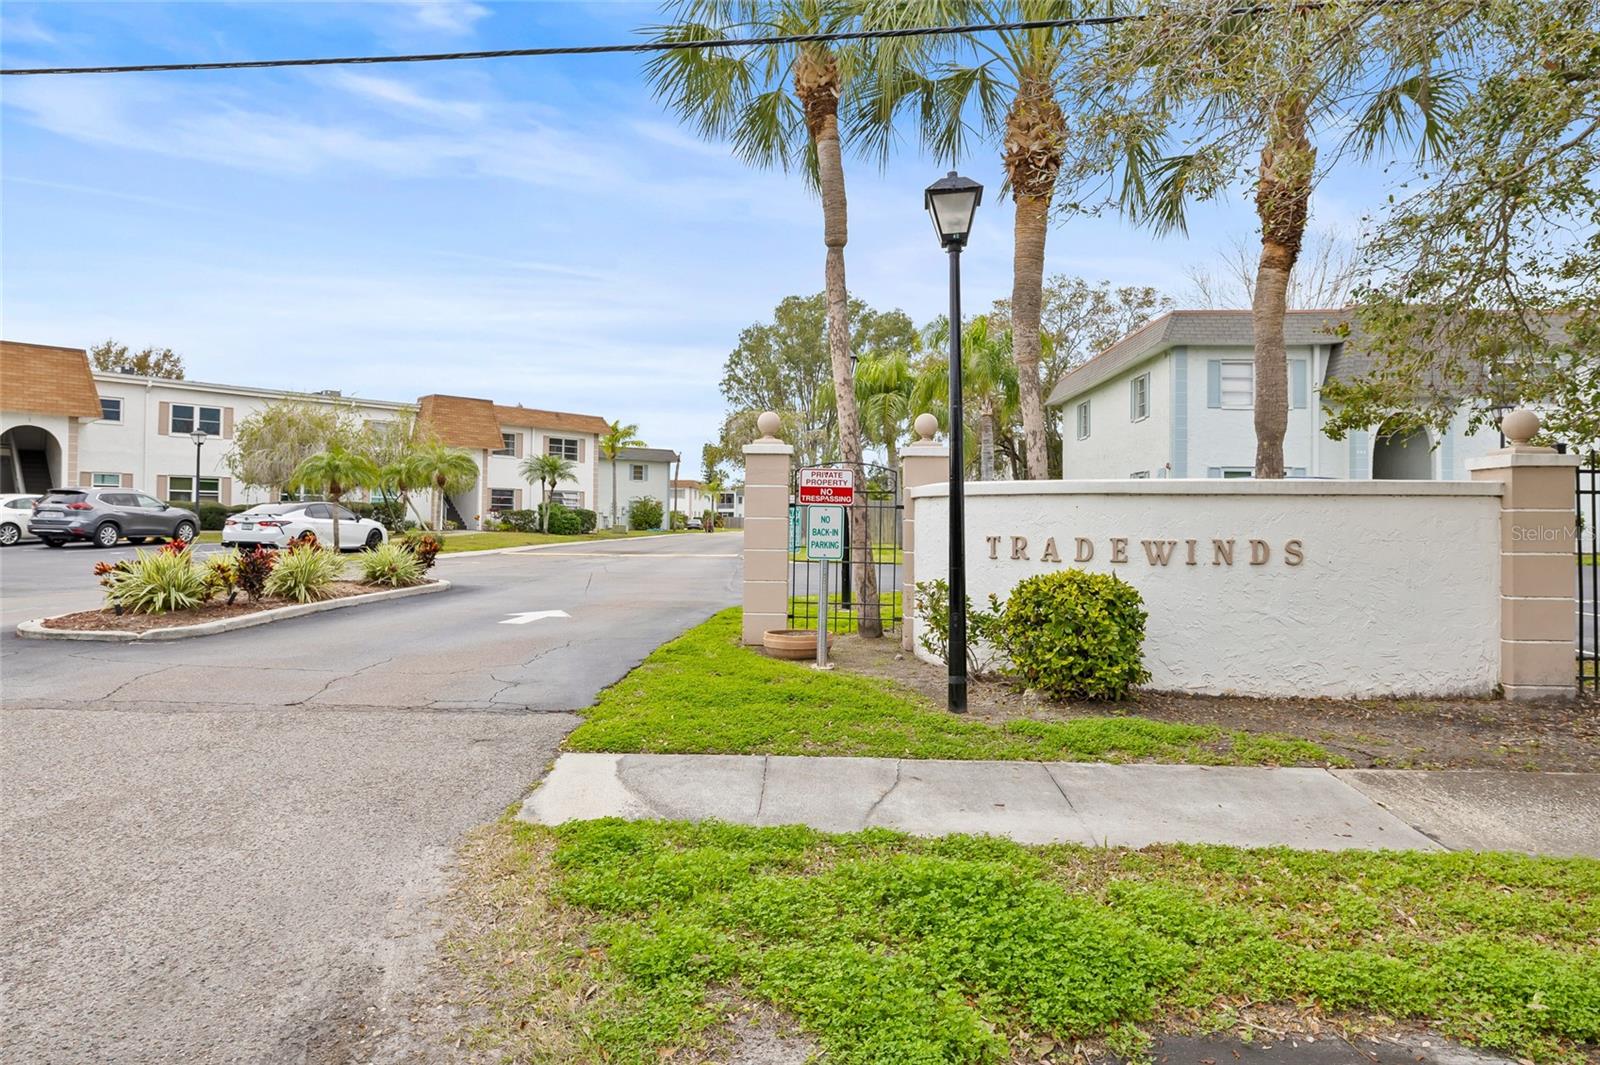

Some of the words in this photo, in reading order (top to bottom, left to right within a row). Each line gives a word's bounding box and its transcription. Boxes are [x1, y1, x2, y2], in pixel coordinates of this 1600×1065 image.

[812, 528, 839, 536] BACK-IN
[811, 541, 839, 549] PARKING
[986, 536, 1304, 566] TRADEWINDS
